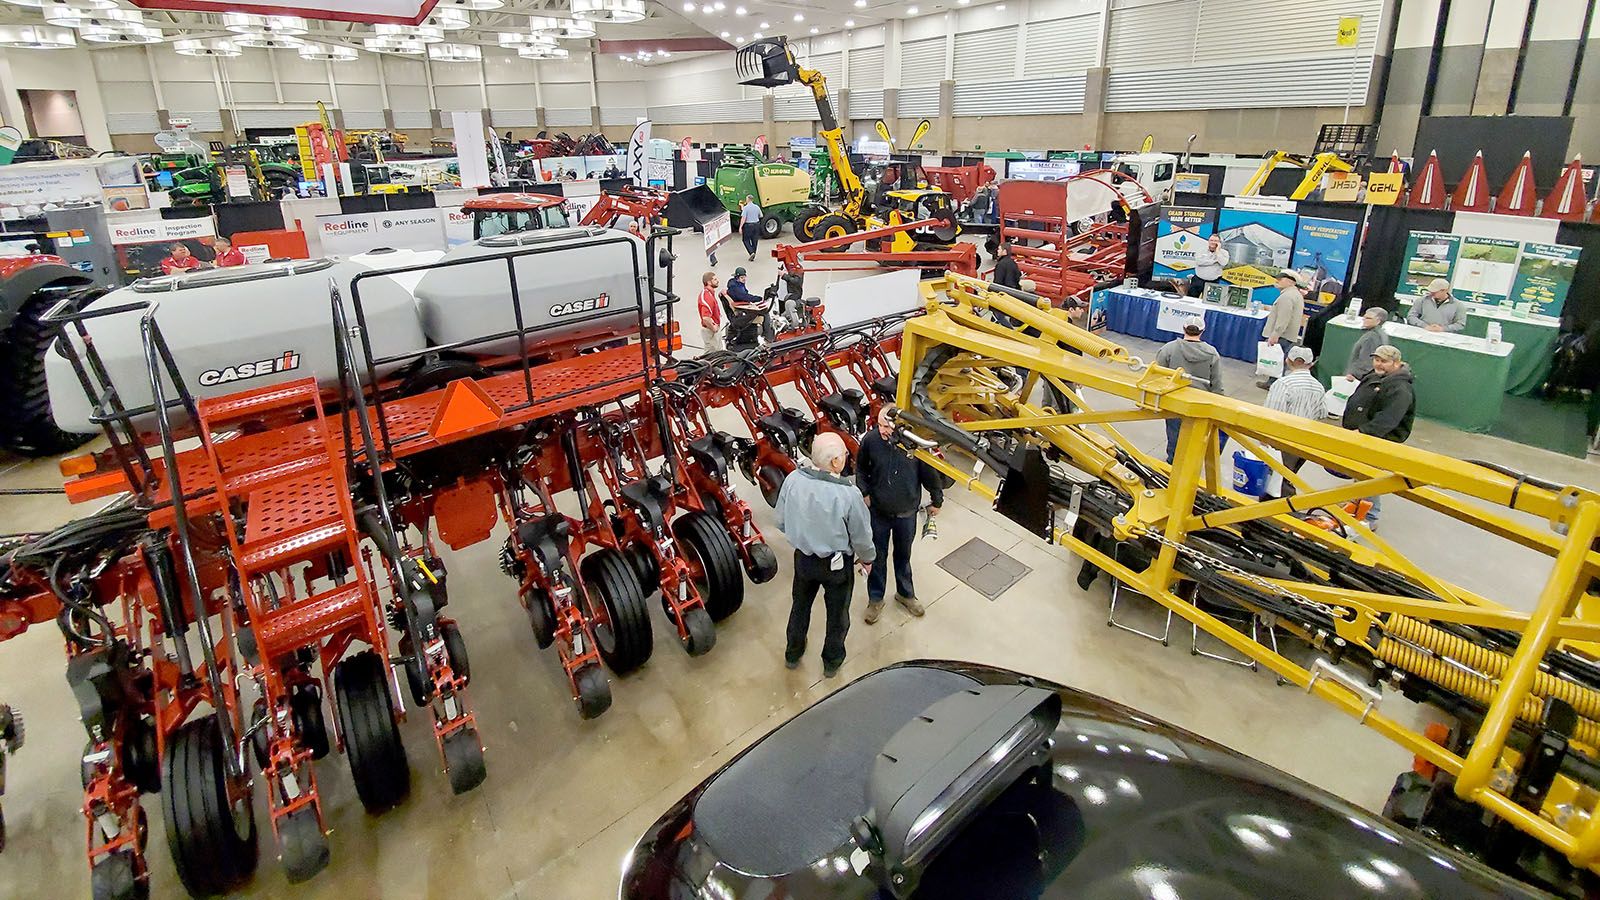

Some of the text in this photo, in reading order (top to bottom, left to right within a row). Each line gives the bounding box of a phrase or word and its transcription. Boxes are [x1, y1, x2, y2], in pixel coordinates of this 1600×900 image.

[1312, 159, 1330, 182] GEHL
[1369, 183, 1398, 193] GEHL
[566, 202, 587, 211] dline
[165, 223, 202, 231] Inspection
[324, 220, 369, 231] Redline
[115, 227, 156, 237] Redline
[1161, 249, 1196, 257] TRI-STATE
[549, 298, 596, 317] CASE
[199, 359, 274, 386] CASE
